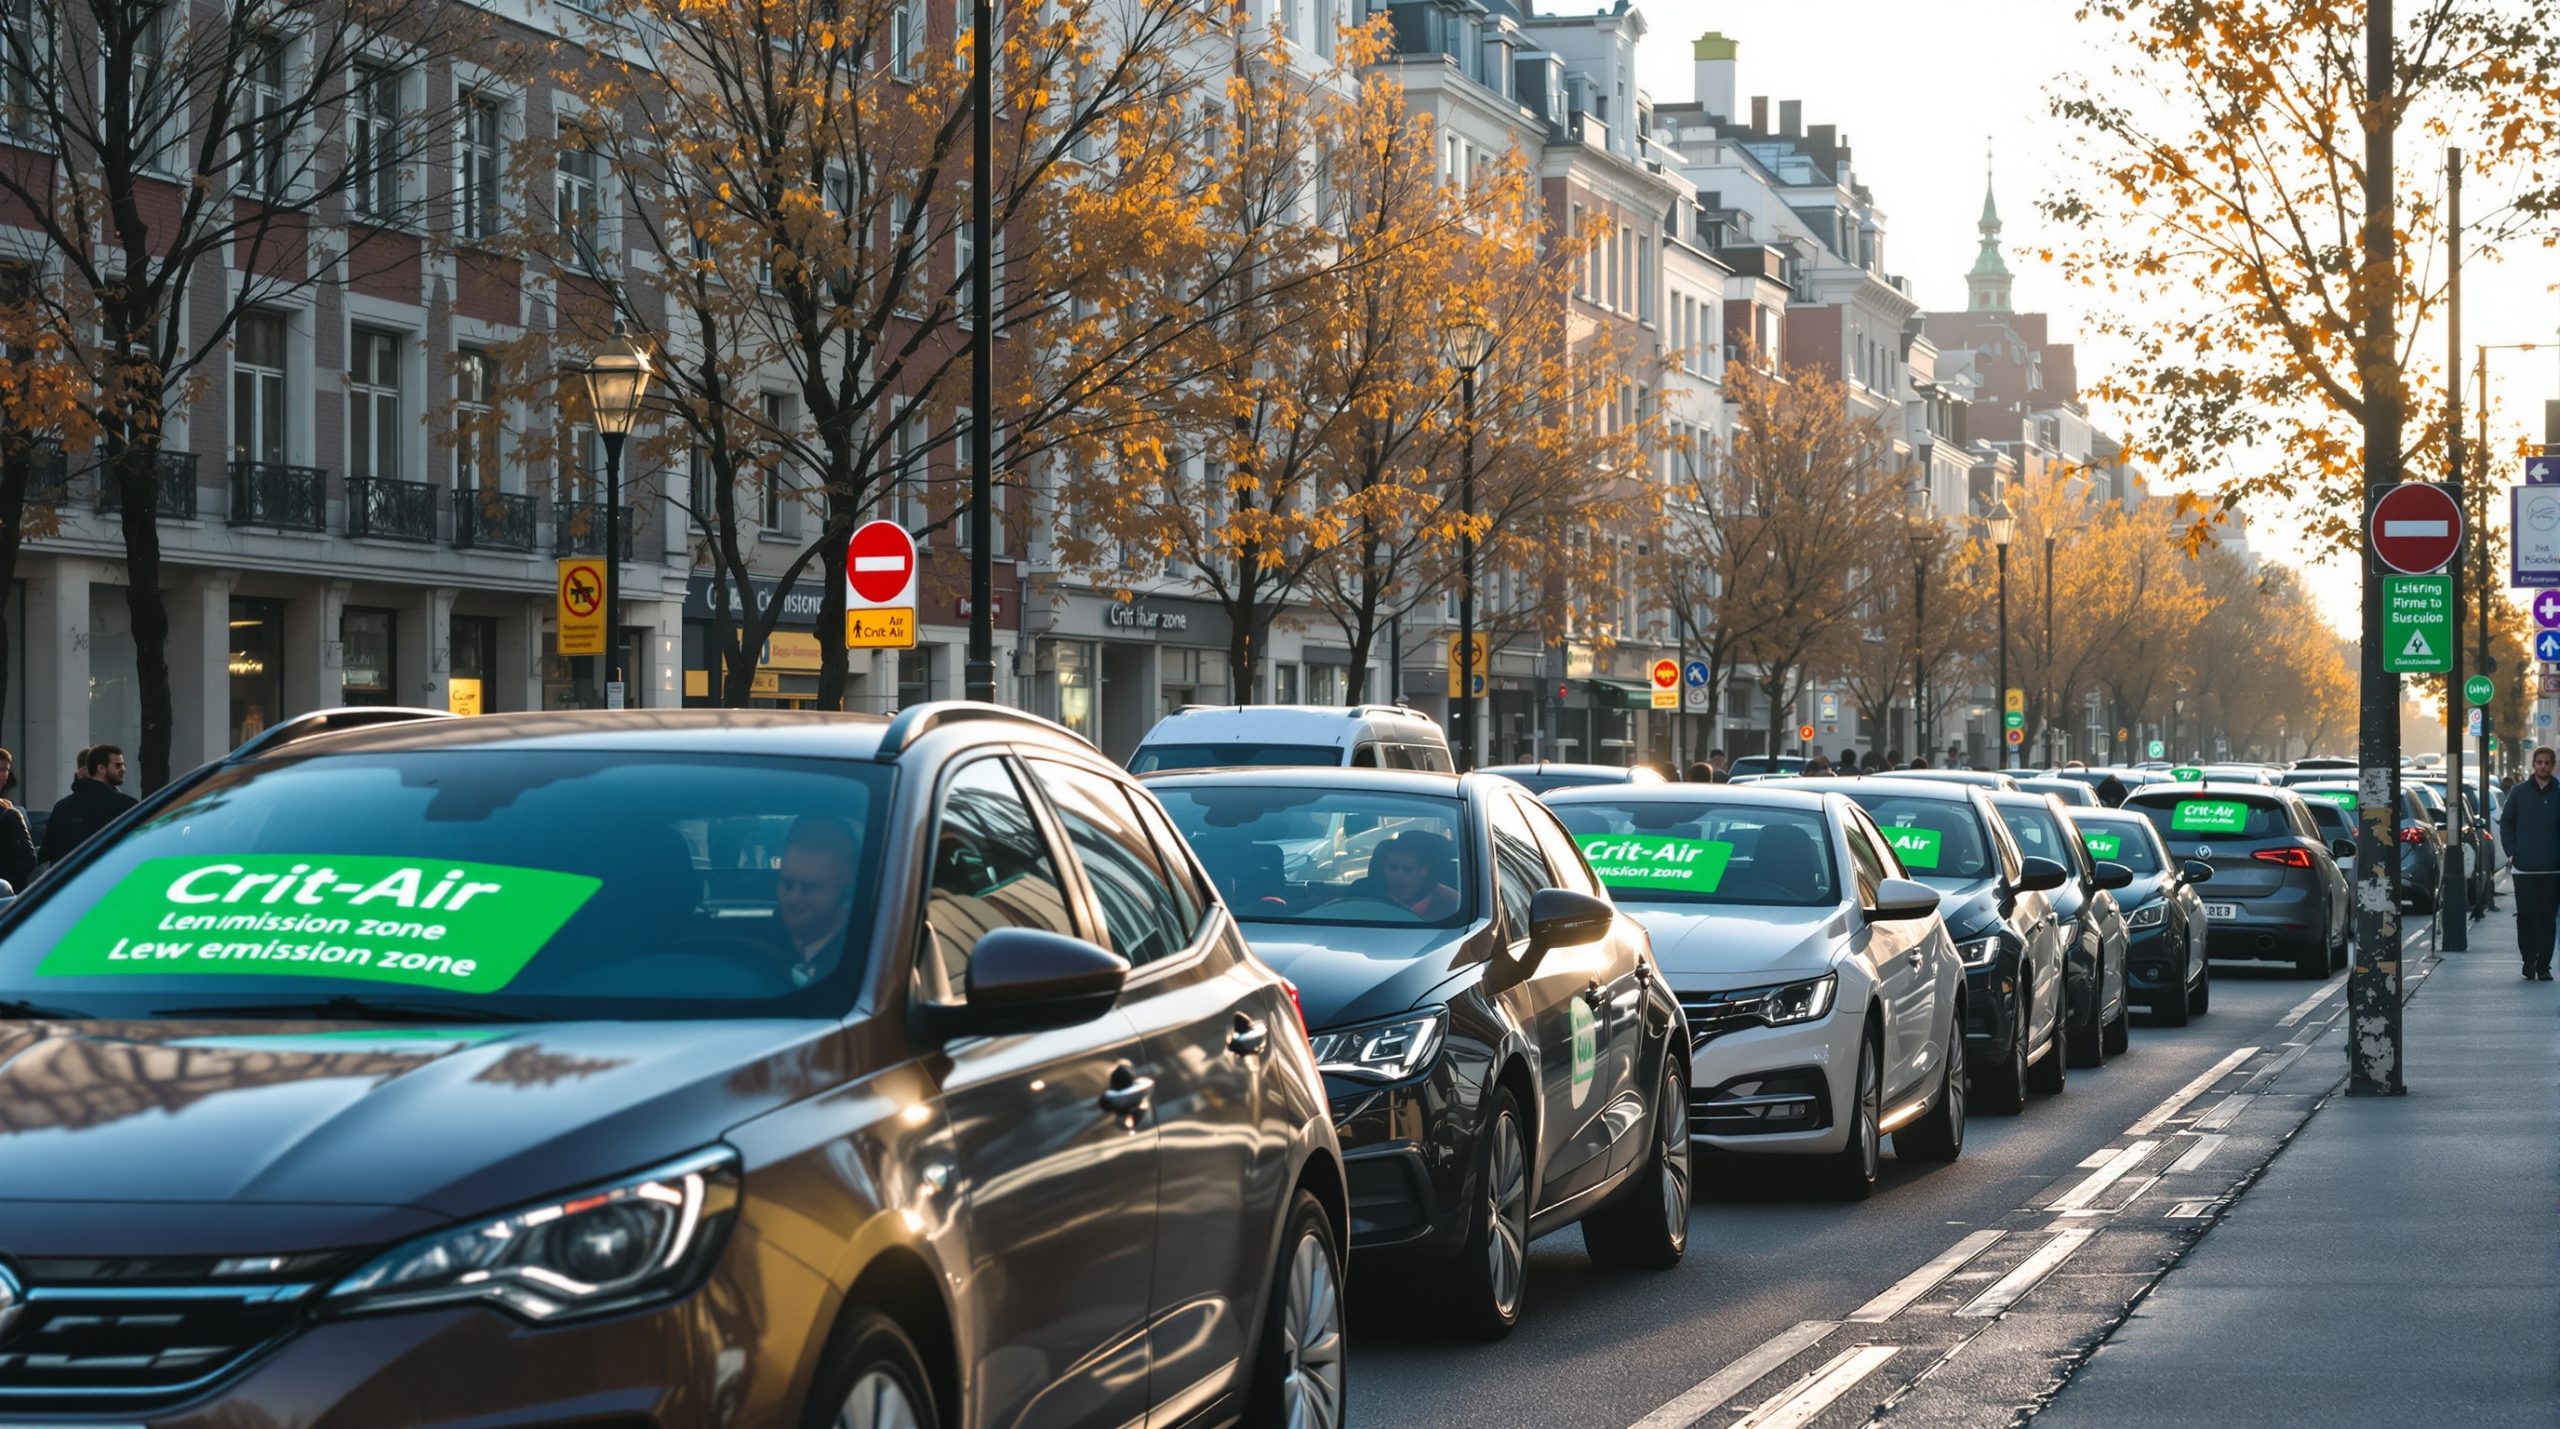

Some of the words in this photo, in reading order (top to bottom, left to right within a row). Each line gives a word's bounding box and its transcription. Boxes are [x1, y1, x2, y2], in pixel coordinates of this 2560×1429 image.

[2430, 598, 2442, 608] to
[1162, 613, 1187, 630] zone
[2184, 804, 2235, 817] Crit-Air
[1894, 835, 1931, 850] Air
[1583, 841, 1704, 863] Crit-Air
[1652, 868, 1693, 879] zone
[166, 863, 502, 912] Crit-Air
[354, 918, 447, 941] zone
[107, 937, 194, 960] Lew
[197, 938, 372, 966] emission
[376, 950, 478, 977] zone
